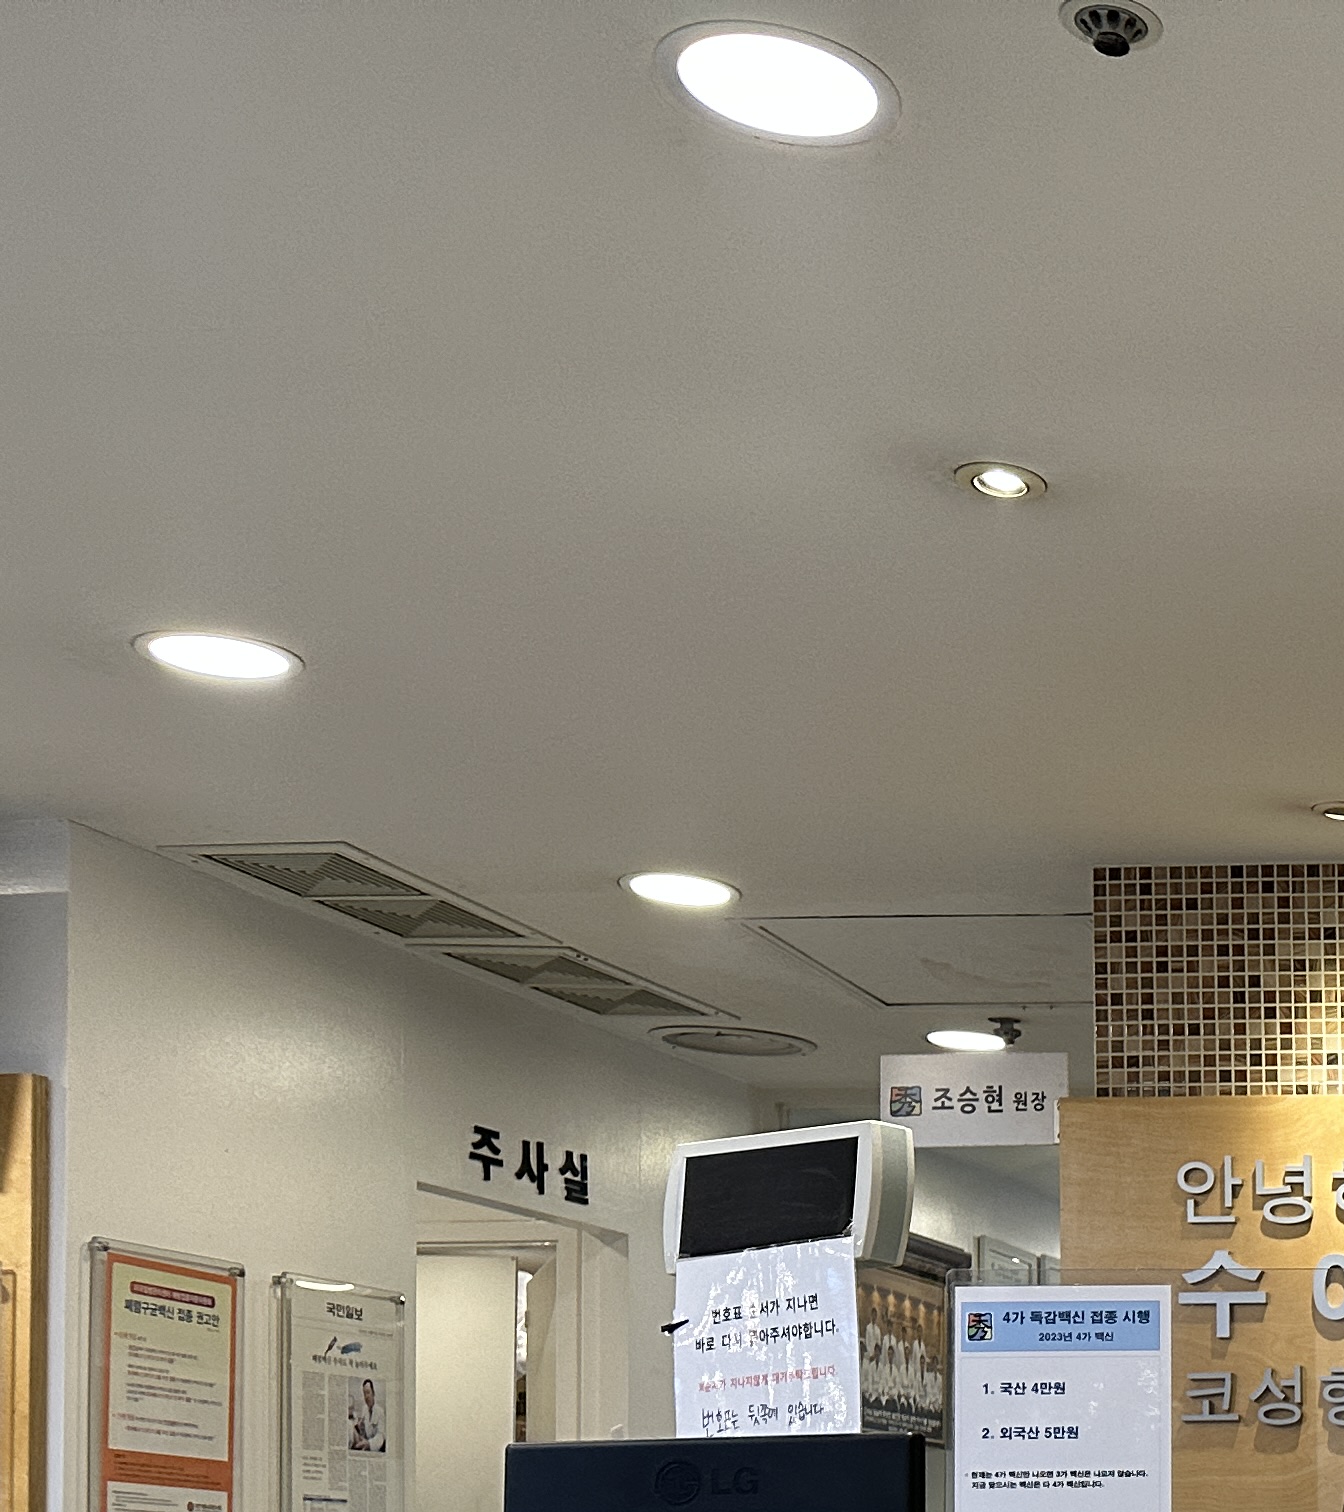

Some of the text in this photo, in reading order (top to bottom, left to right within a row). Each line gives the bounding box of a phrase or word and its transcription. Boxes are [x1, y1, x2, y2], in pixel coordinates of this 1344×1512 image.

[932, 1085, 1046, 1114] 조승현 원장
[468, 1125, 589, 1205] 주사실
[326, 1302, 363, 1321] 국민일보
[712, 1306, 742, 1324] 번호표
[786, 1293, 818, 1312] 지나면
[1002, 1310, 1150, 1324] 4가 독감백신 접종 시행
[696, 1337, 715, 1353] 바로
[1039, 1332, 1114, 1342] 2023년 4가 백신
[982, 1382, 1066, 1395] 1. 국산 4만원
[982, 1427, 1079, 1440] 2. 외국산 5만원
[711, 1467, 759, 1496] LG
